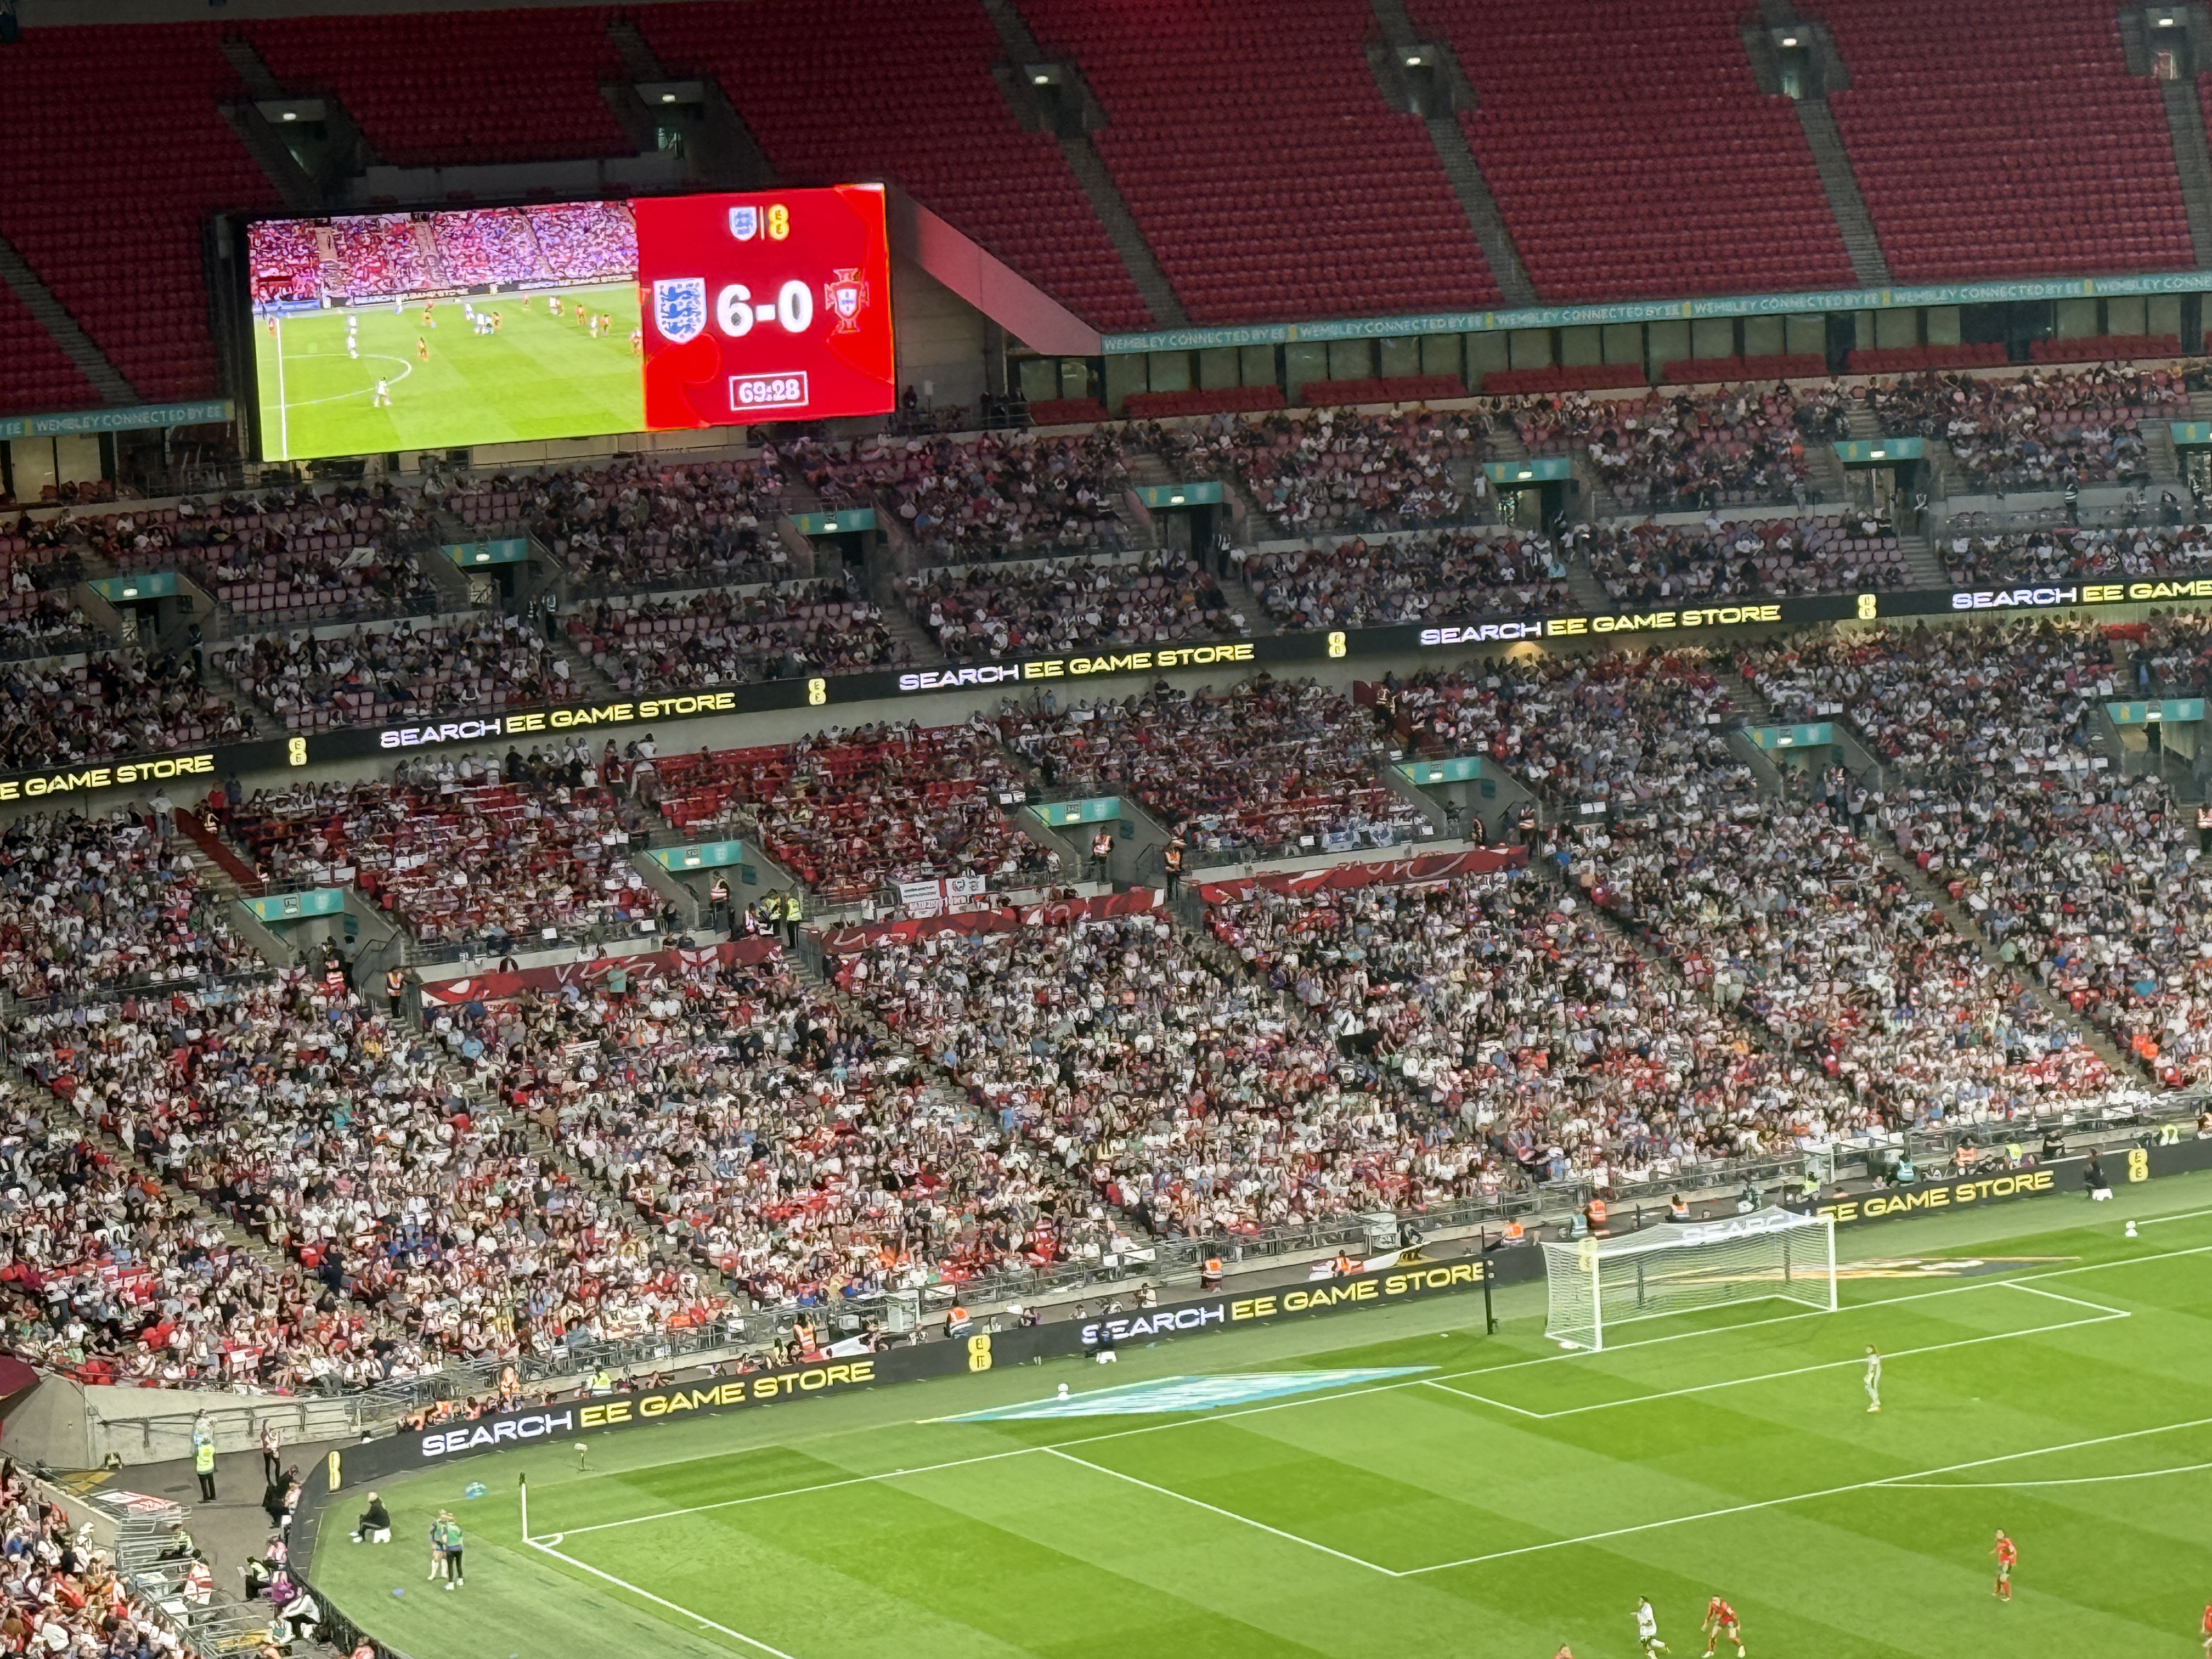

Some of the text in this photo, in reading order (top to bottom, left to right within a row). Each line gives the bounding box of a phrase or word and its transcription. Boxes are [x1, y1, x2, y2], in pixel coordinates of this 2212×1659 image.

[717, 280, 813, 337] 6-0
[1364, 318, 1446, 334] CONNECTED
[1561, 306, 1643, 321] CONNECTED
[1105, 336, 1166, 351] WEMBLEY
[1169, 330, 1249, 347] CONNECTED
[739, 379, 800, 403] 69:28
[103, 410, 185, 426] CONNECTED
[1953, 580, 2212, 609] SEARCH EE GAME
[1421, 605, 1781, 646] SEARCH EE GAME STORE
[900, 644, 1254, 690] SEARCH EE GAME STORE
[381, 692, 735, 748] SEARCH EE GAME STORE
[0, 754, 214, 800] E GAME STORE
[1864, 1187, 1950, 1217] GAME
[1956, 1170, 2055, 1204] STORE
[1232, 1295, 1277, 1321] EE
[1284, 1279, 1379, 1311] GAME
[422, 1361, 876, 1457] SEARCH EE GAME STORE
